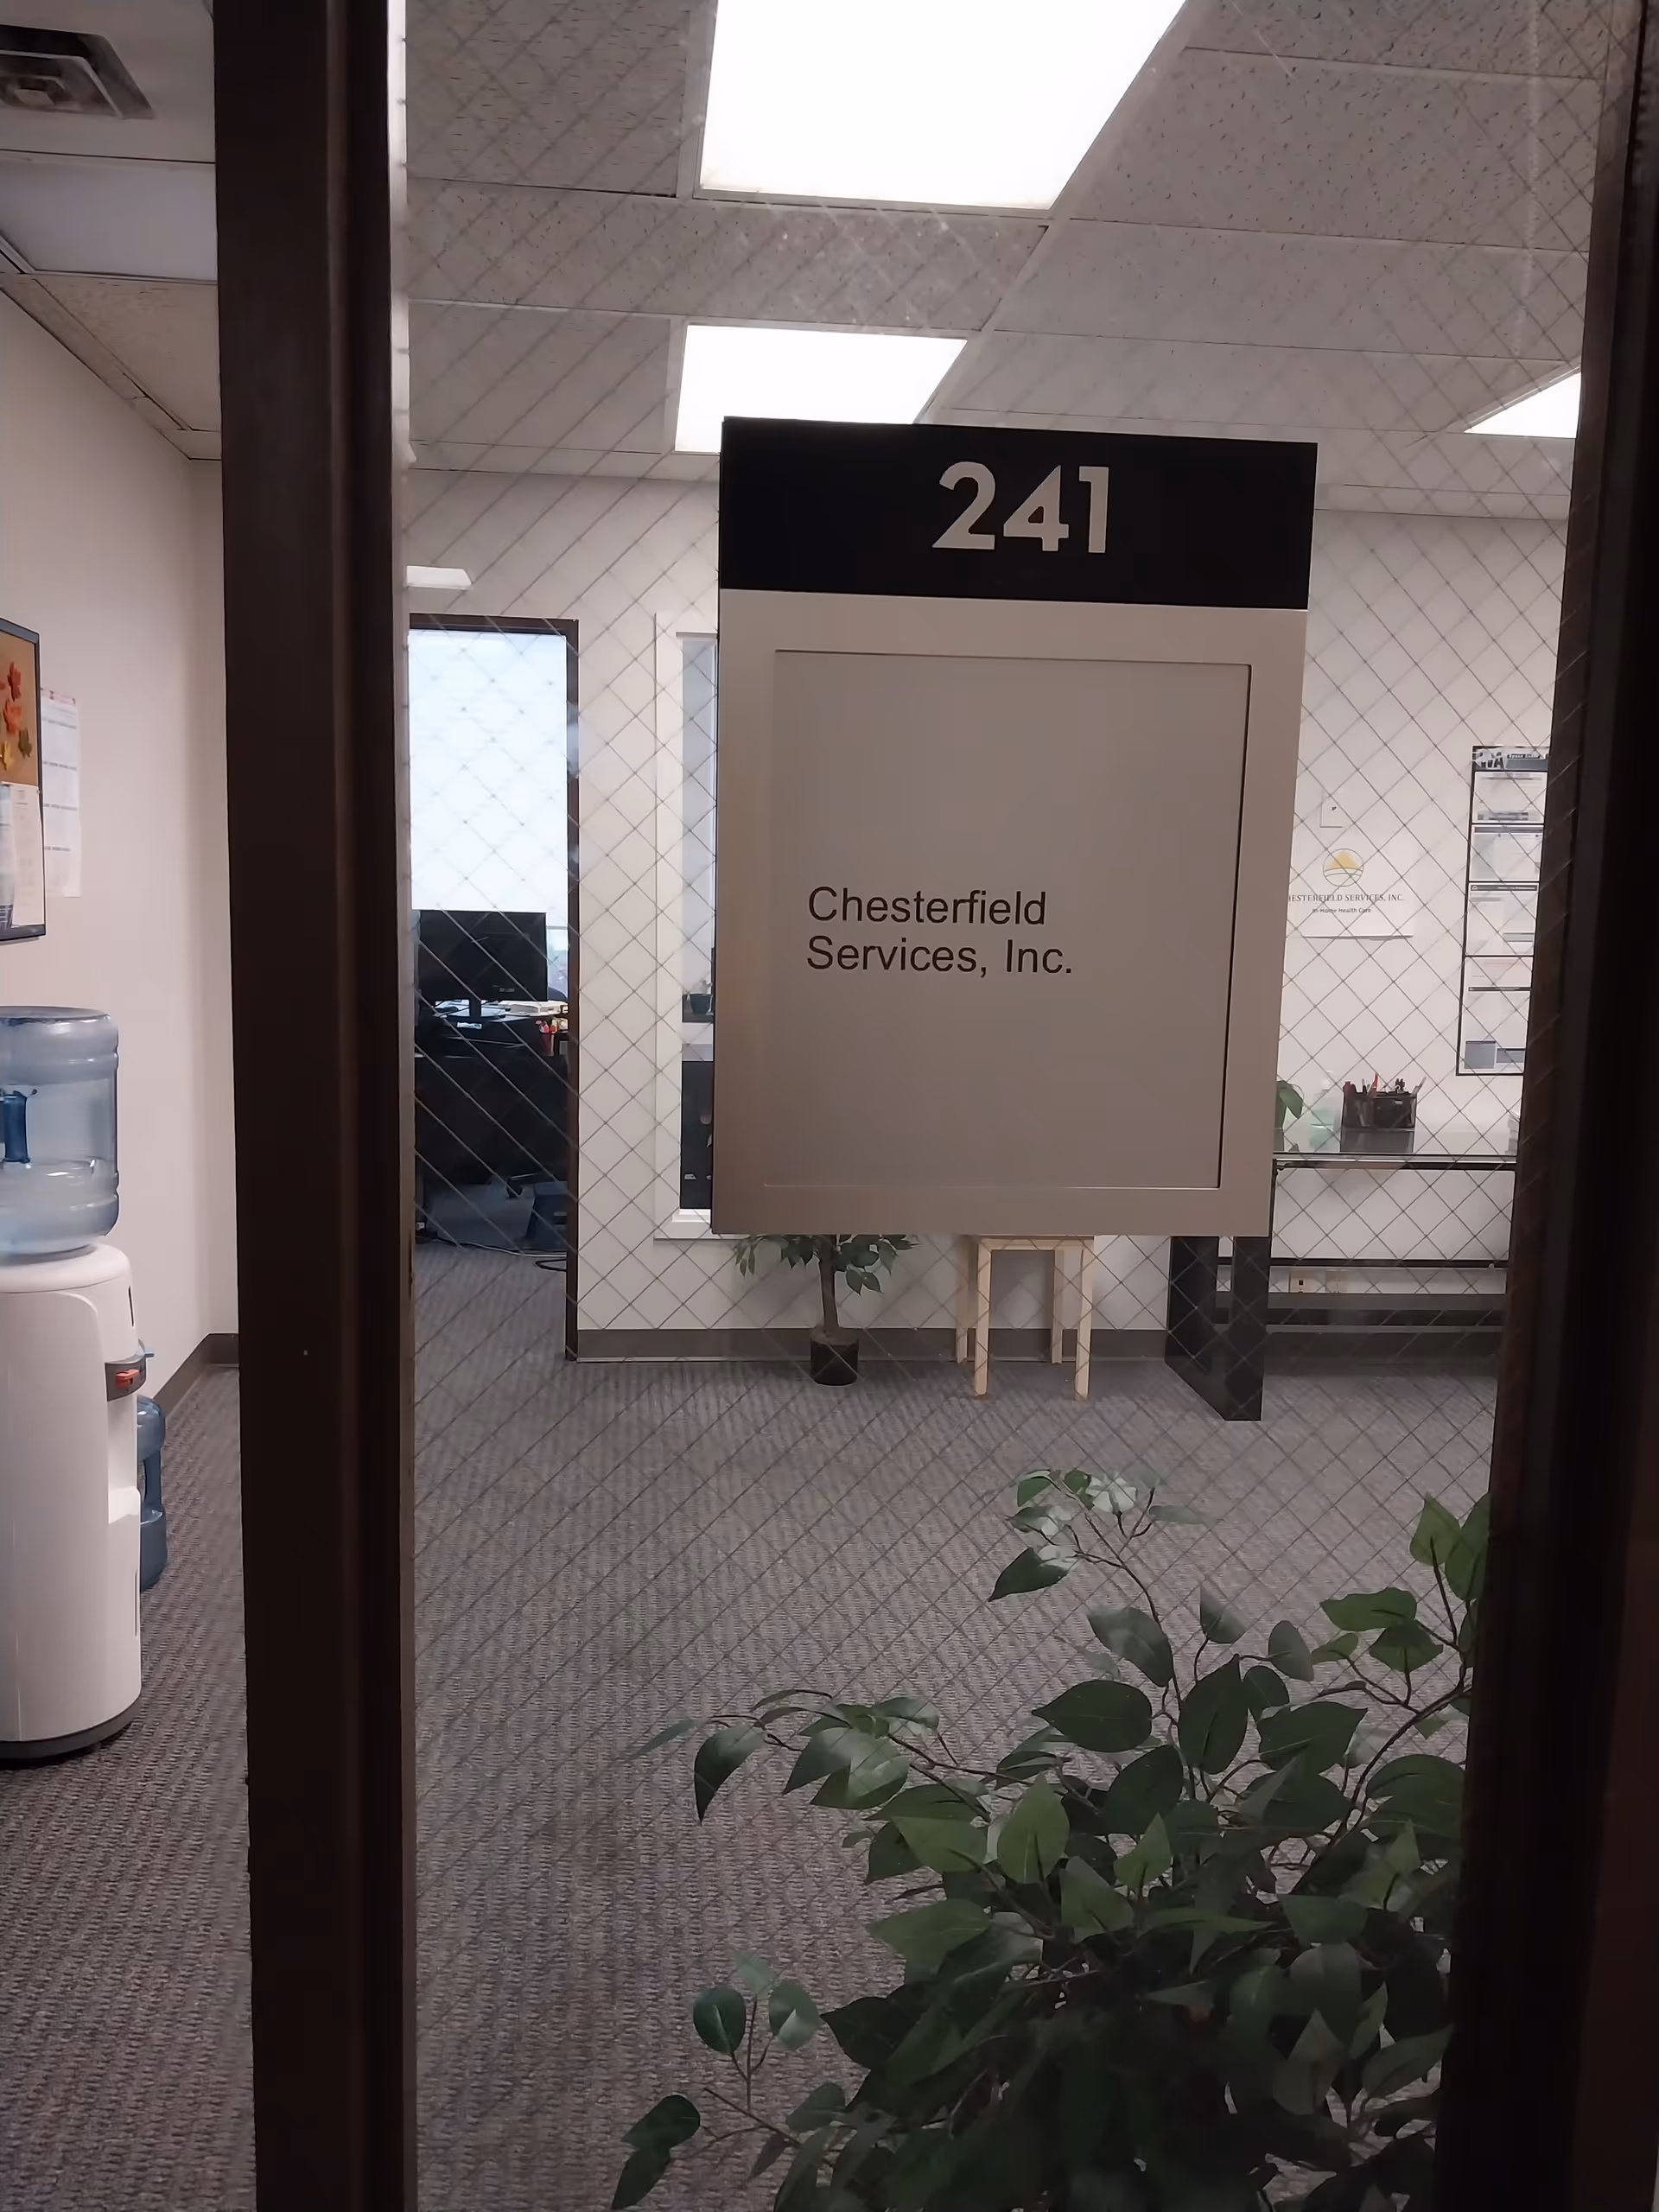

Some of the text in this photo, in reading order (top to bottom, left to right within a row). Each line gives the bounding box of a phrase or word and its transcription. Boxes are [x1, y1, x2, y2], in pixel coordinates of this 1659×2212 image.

[931, 461, 1109, 554] 241
[808, 886, 1046, 925] Chesterfield
[806, 935, 1072, 979] Services, Inc.
